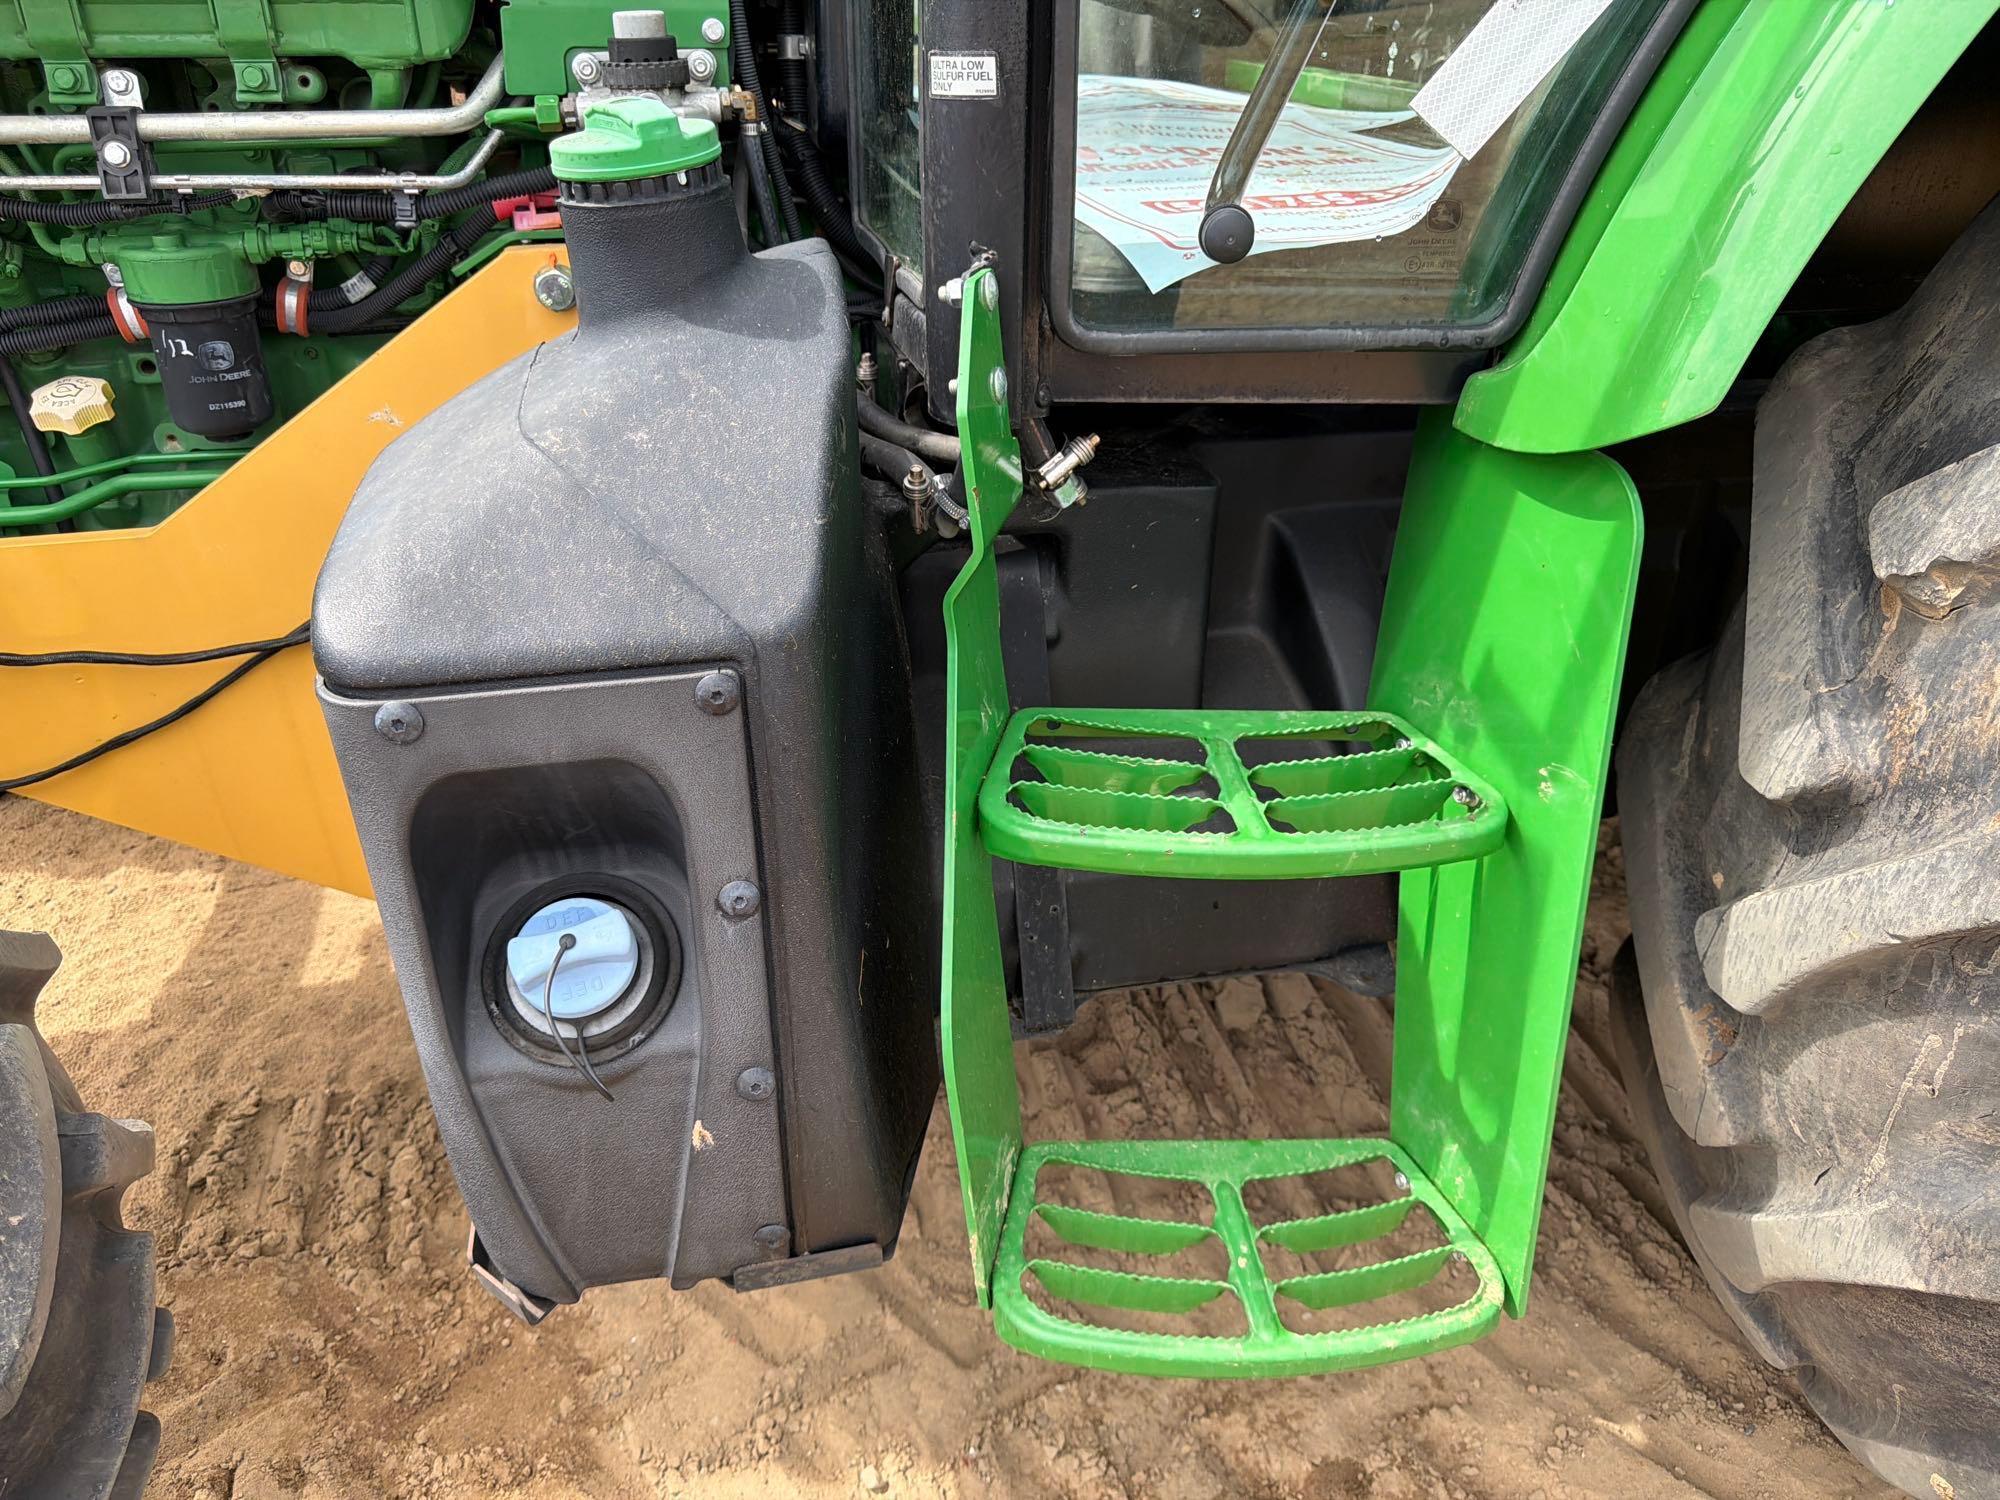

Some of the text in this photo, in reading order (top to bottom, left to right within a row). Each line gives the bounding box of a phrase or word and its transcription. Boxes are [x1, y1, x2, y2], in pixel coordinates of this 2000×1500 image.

[932, 60, 985, 70] ULTRA LOW
[933, 71, 993, 81] SULFUR FUEL
[933, 82, 953, 91] ONLY
[188, 369, 252, 384] JOHN DEERE
[545, 907, 588, 931] DEF
[562, 975, 604, 1002] DEF
